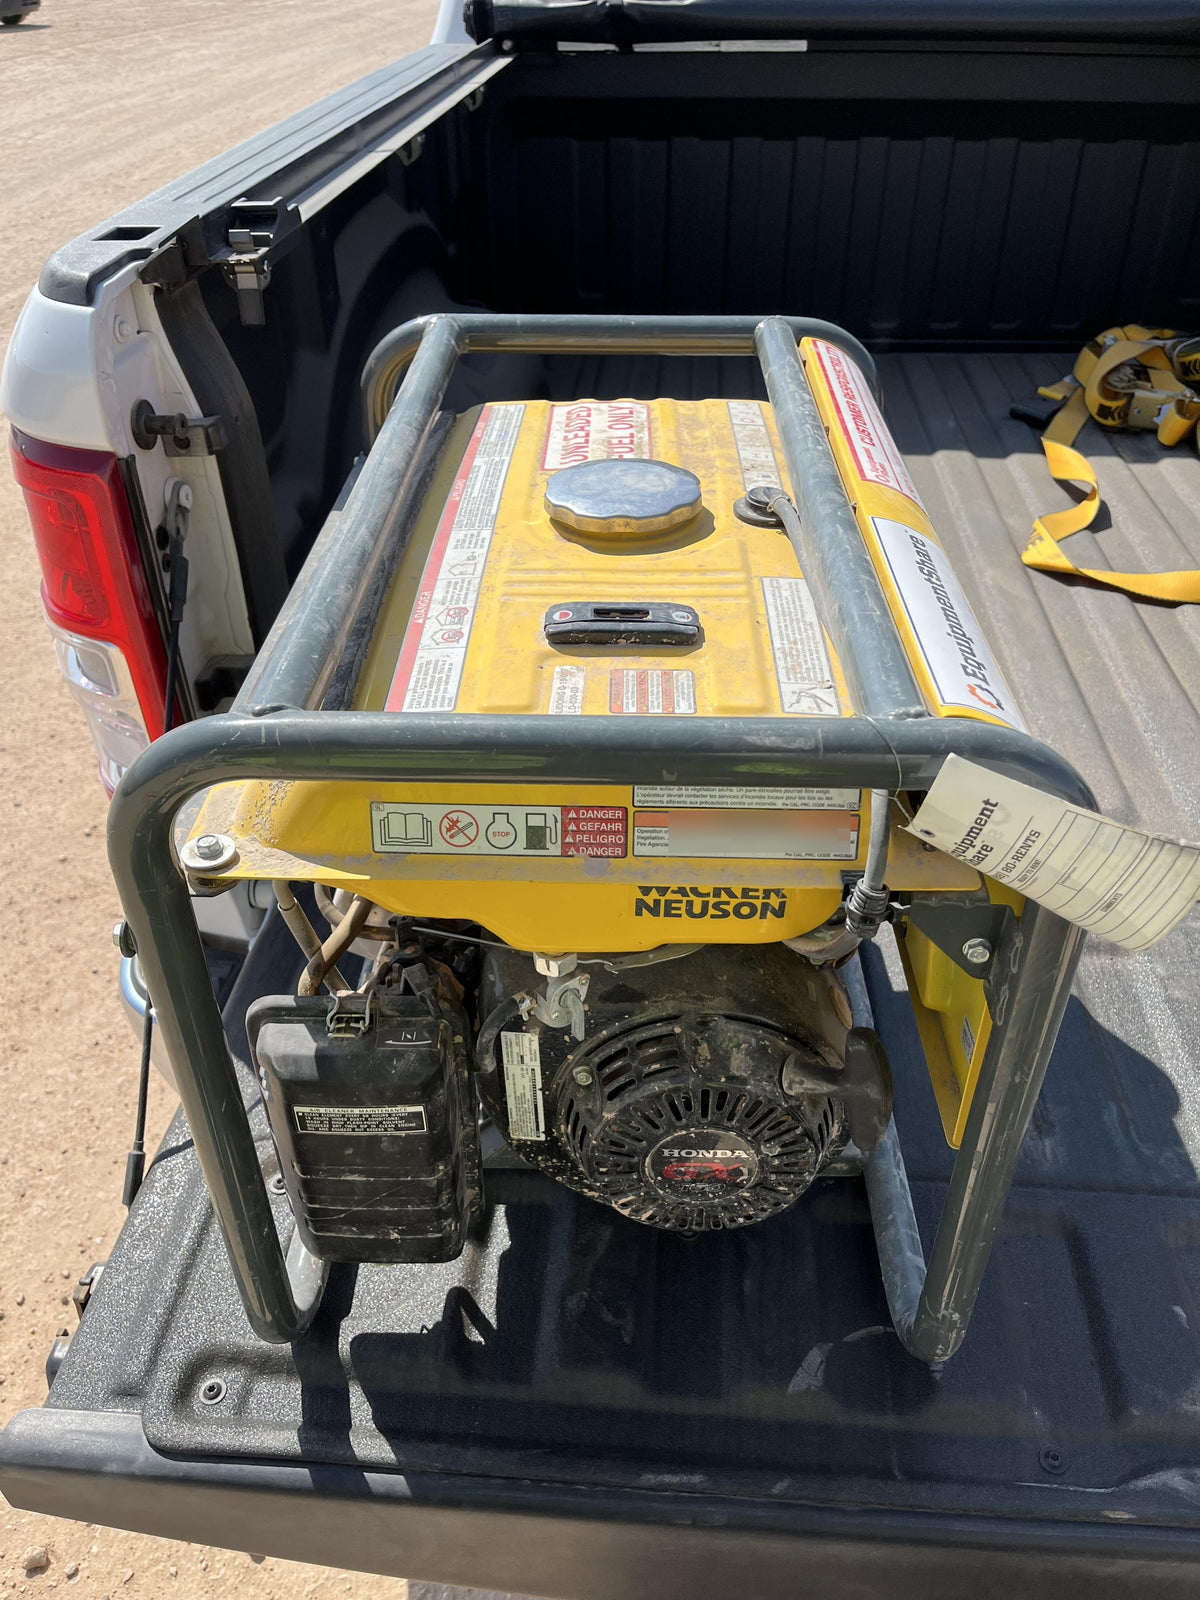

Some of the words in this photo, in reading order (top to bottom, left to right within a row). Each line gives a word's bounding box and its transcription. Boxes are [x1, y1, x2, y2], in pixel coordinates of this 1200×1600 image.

[608, 405, 634, 430] ONLY
[846, 400, 876, 447] CUSTOMER
[560, 406, 592, 466] UNLEADED
[414, 591, 431, 618] DANGER
[912, 535, 990, 686] EquipmentShare
[580, 810, 622, 819] DANGER
[580, 822, 622, 831] GEFAHR
[950, 798, 999, 860] quipment
[576, 834, 624, 844] PELIGRO
[579, 846, 622, 856] DANGER
[965, 844, 994, 868] hare
[1001, 829, 1042, 874] 80-RENTS
[1032, 860, 1042, 872] RENT
[634, 898, 787, 920] NEUSON
[1100, 892, 1123, 913] COMMENTS
[662, 1148, 750, 1158] HONDA
[662, 1162, 744, 1181] GX
